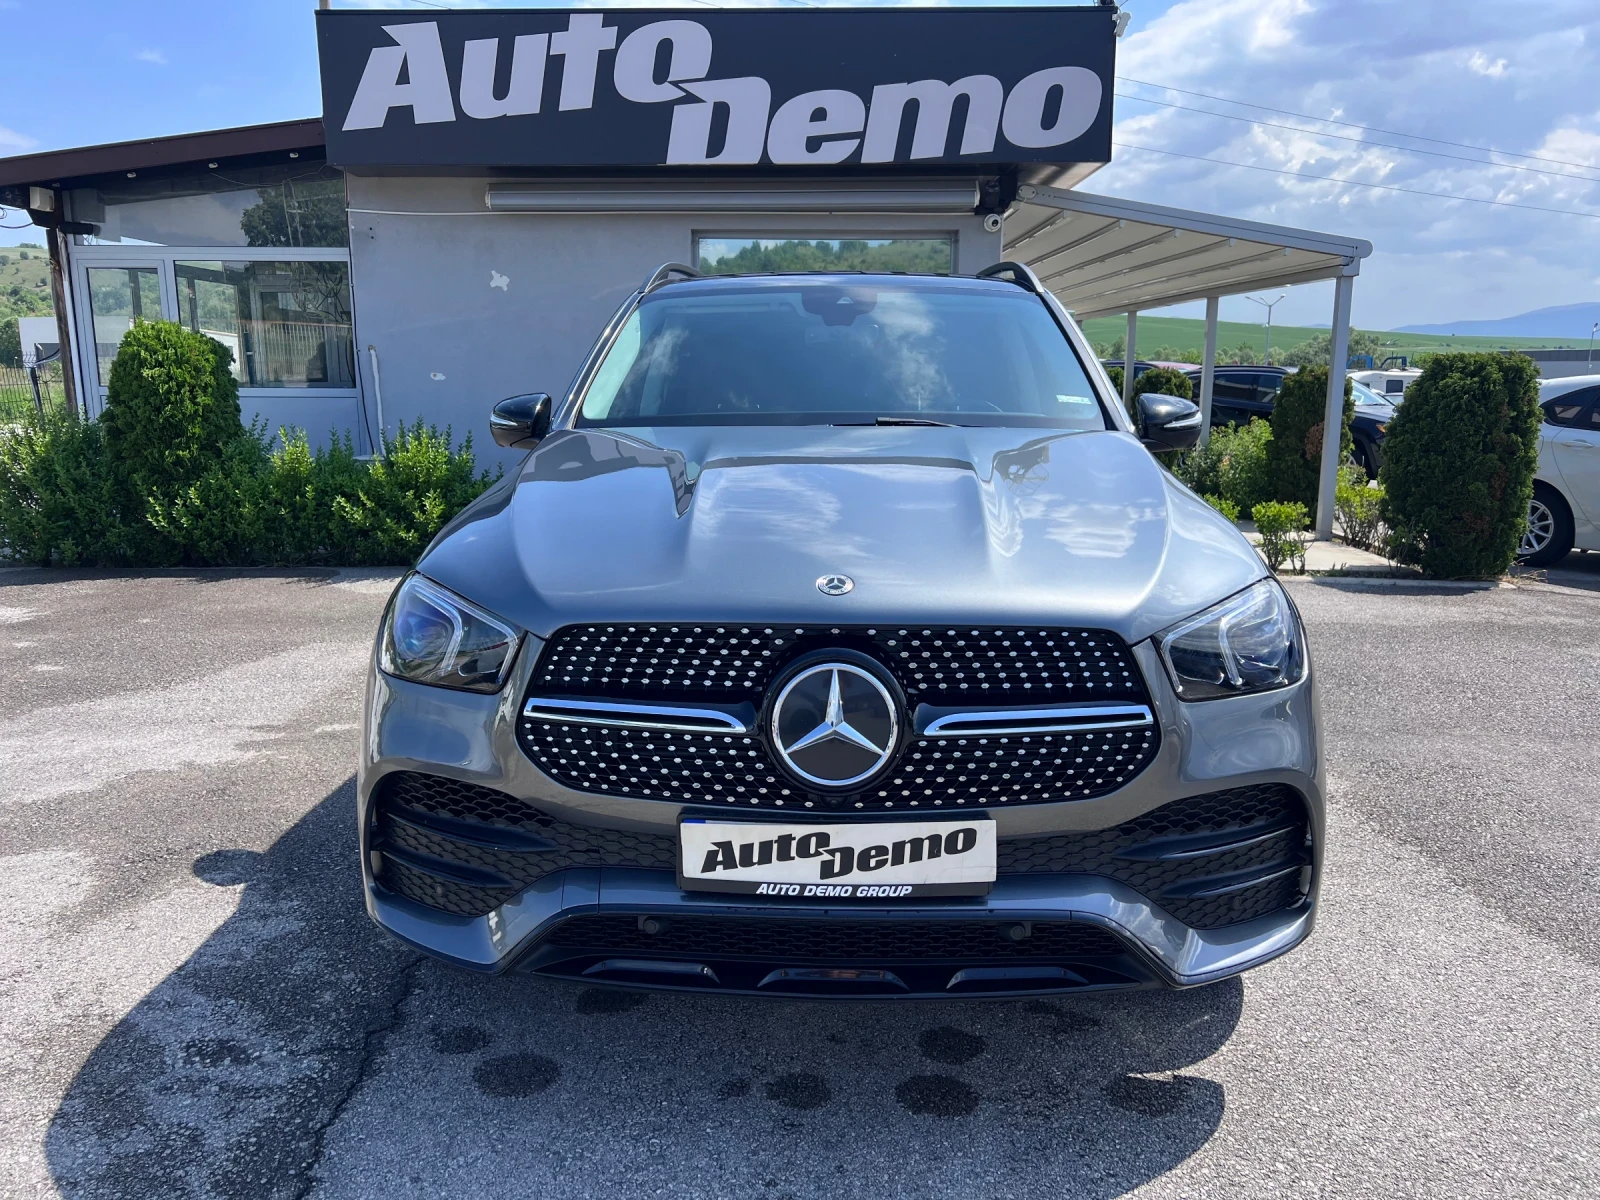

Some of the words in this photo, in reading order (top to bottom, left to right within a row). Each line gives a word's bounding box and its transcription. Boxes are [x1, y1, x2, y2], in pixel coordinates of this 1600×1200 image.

[343, 13, 713, 131] Auto
[665, 66, 1102, 164] Demo
[701, 832, 830, 873] Auto
[819, 828, 977, 880] Demo
[756, 884, 800, 896] AUTO
[804, 885, 852, 897] DEMO
[856, 885, 912, 897] GROUP
